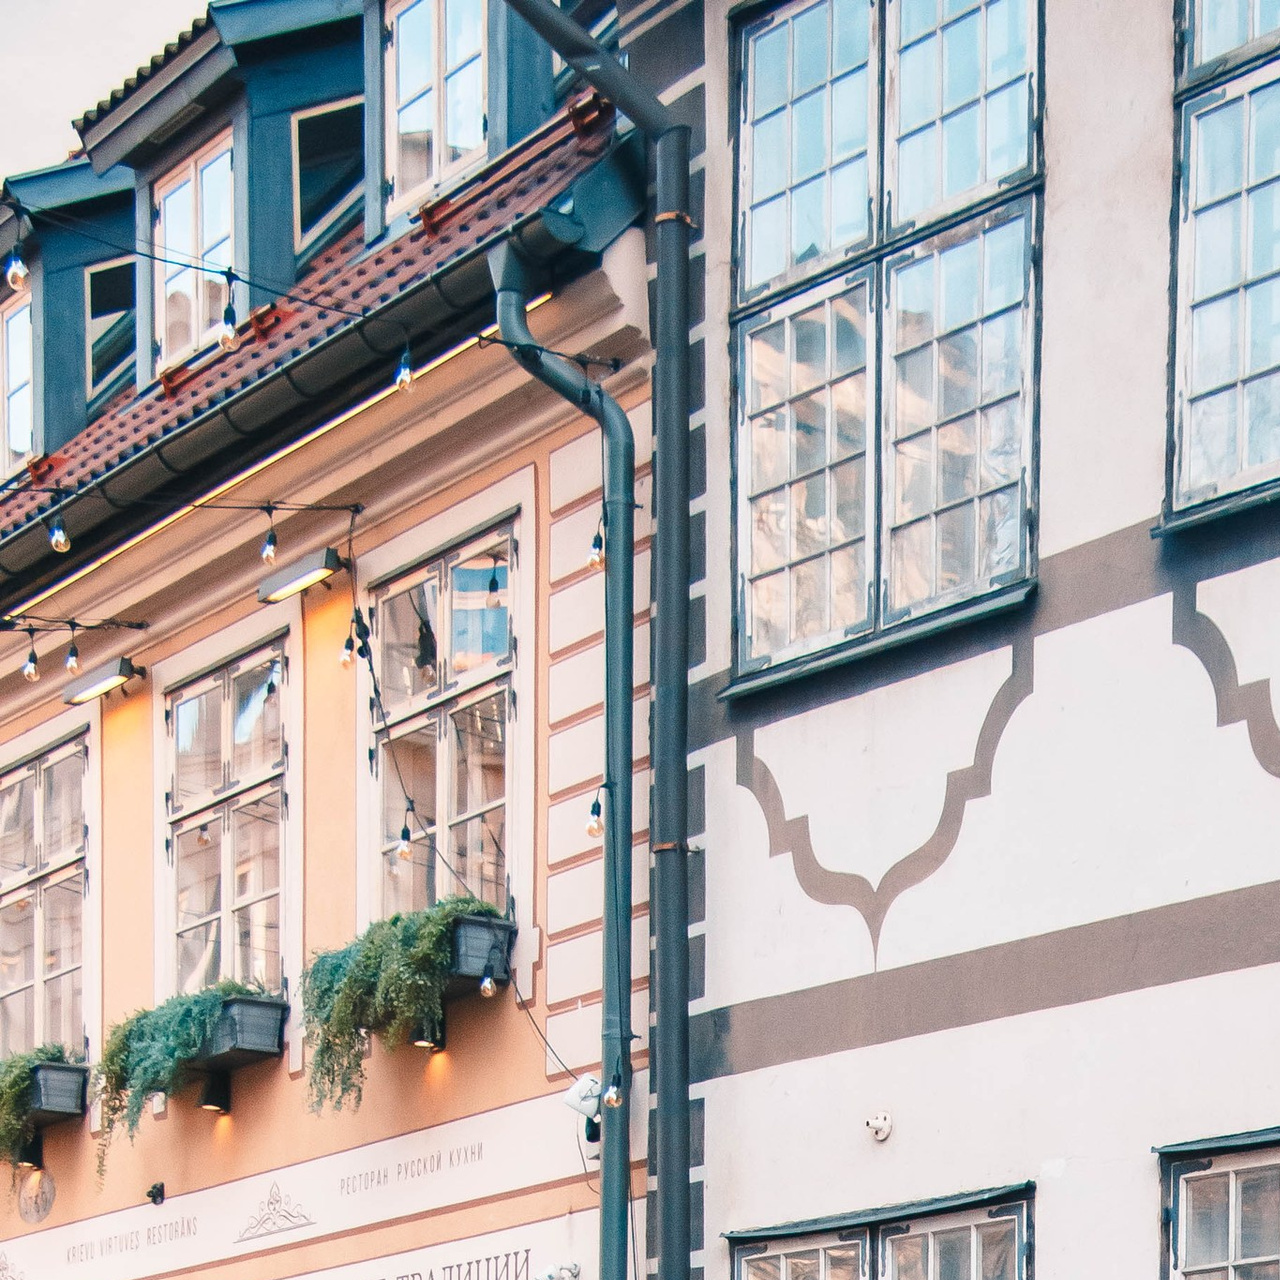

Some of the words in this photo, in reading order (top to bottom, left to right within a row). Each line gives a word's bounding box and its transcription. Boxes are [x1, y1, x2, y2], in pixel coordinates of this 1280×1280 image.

[340, 1168, 389, 1196] РЕСТОРАН
[397, 1150, 442, 1182] РУССКОЙ
[449, 1142, 484, 1168] КУХНИ
[146, 1216, 198, 1246] RESTORĀNS
